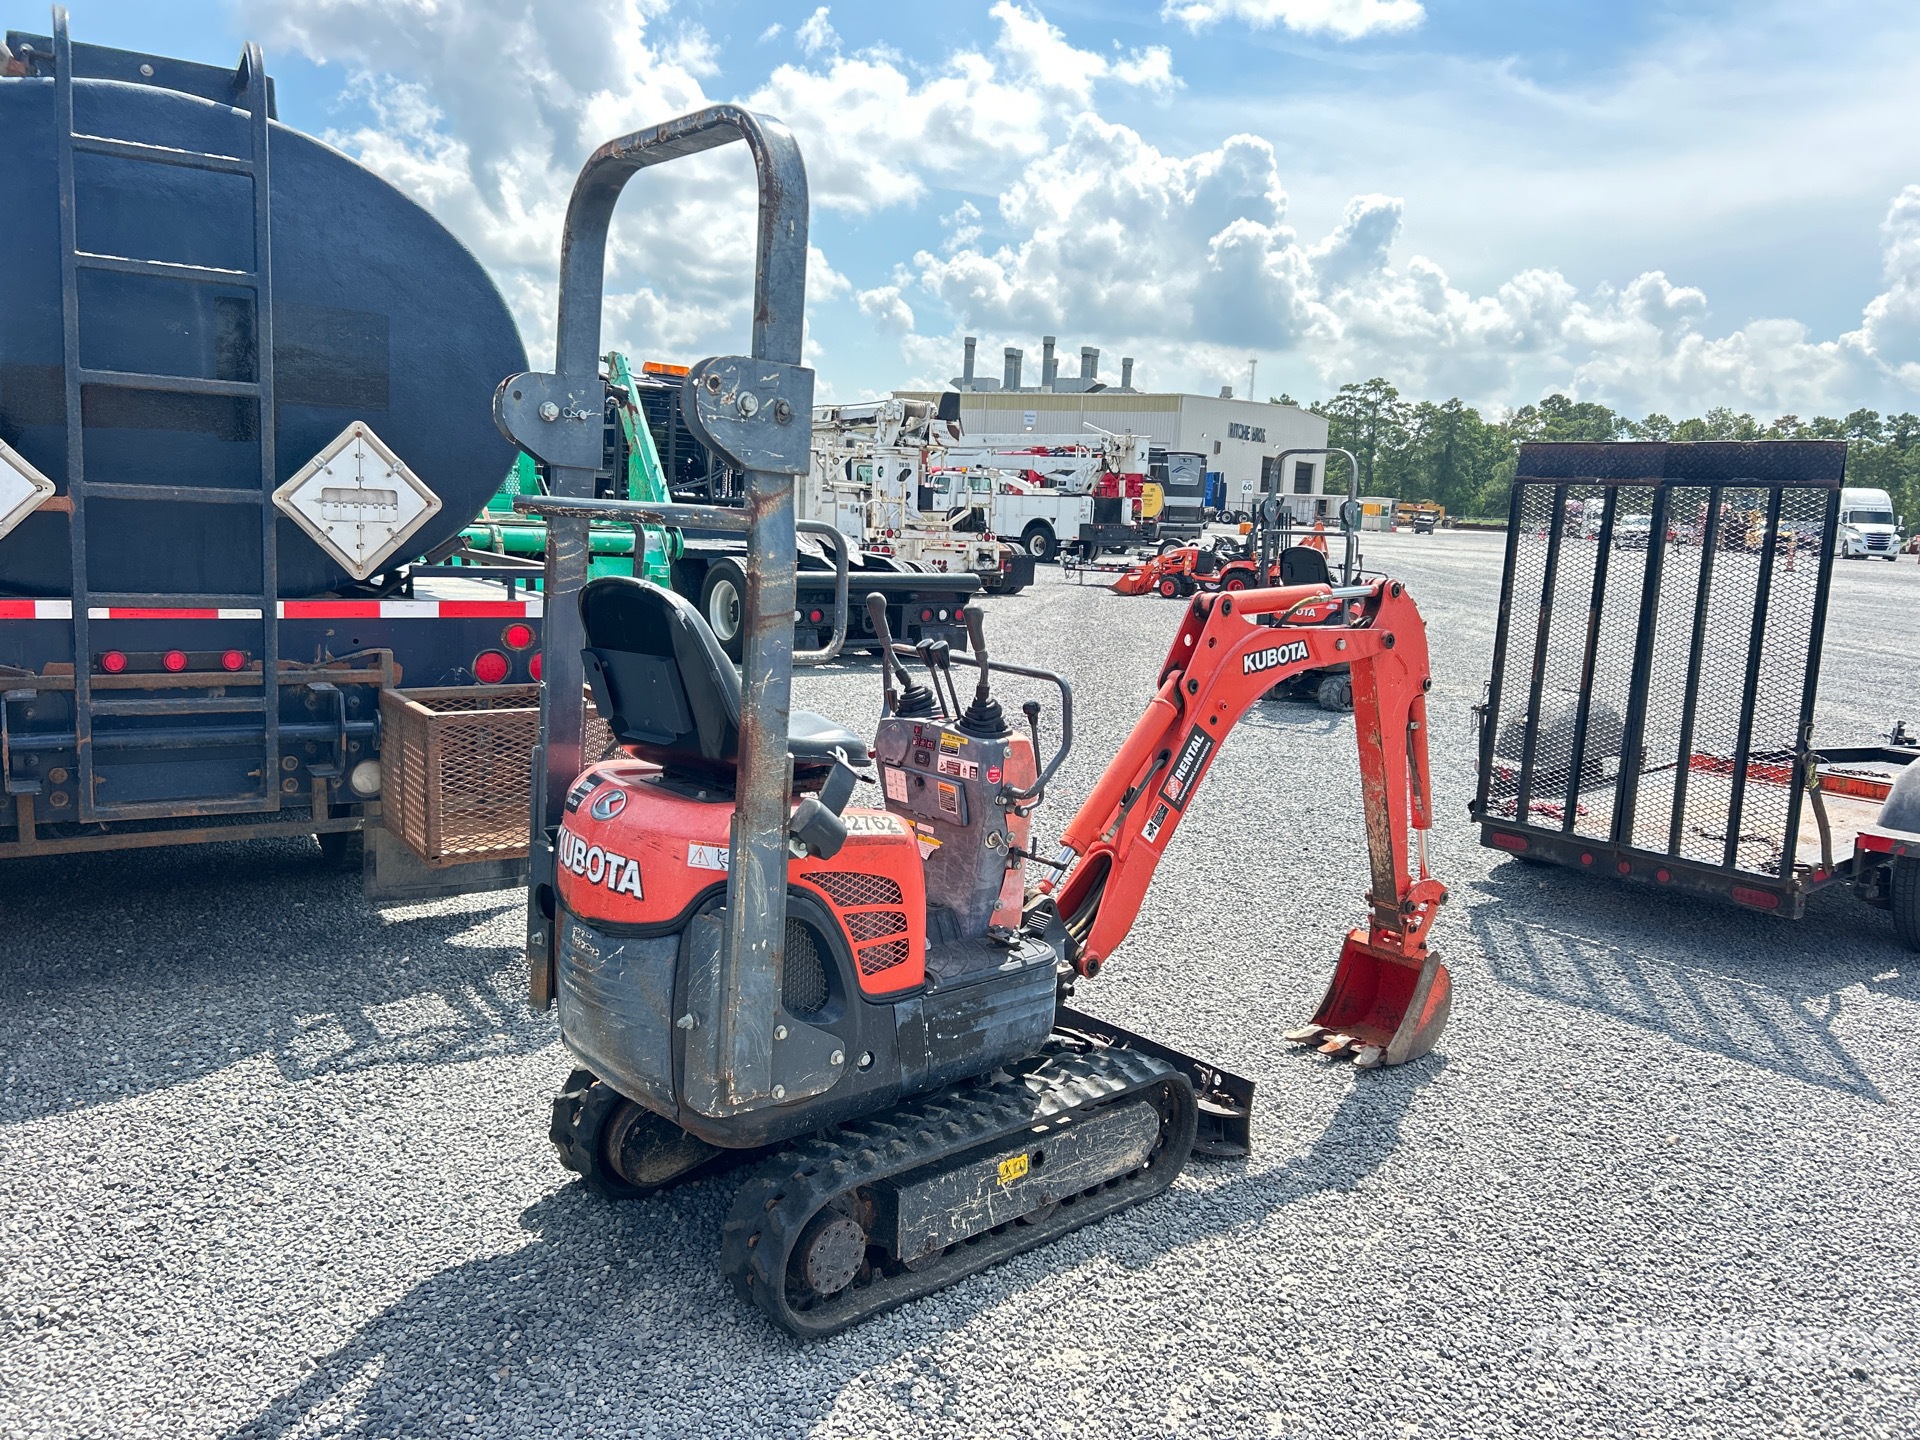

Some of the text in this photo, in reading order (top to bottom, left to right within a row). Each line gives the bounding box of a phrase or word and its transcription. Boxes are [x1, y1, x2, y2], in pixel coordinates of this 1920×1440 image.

[1243, 641, 1308, 673] KUBOTA
[1175, 734, 1205, 781] RENTAL
[1179, 741, 1211, 801] homedepot.com/rentals
[557, 826, 643, 899] KUBOTA
